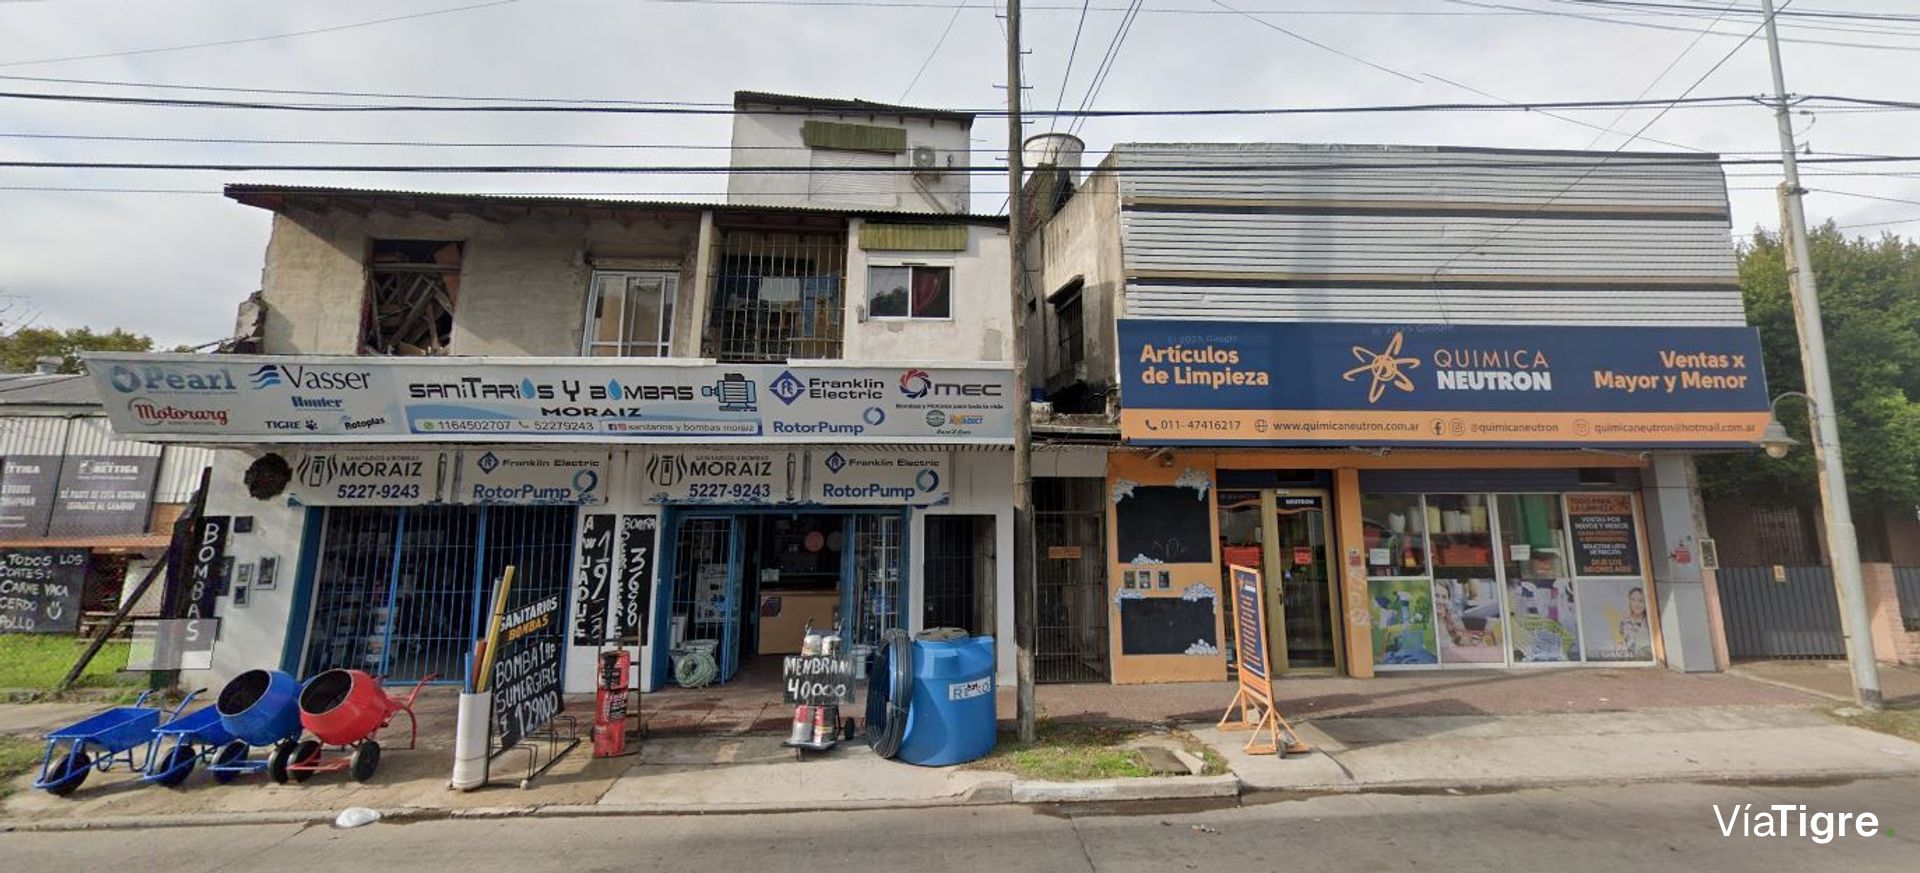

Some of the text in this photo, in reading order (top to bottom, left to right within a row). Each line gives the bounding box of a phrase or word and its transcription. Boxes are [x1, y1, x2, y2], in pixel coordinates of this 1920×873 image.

[1140, 344, 1239, 364] Artículos
[1434, 349, 1549, 369] QUIMICA
[1659, 351, 1746, 368] Ventas x
[145, 368, 237, 390] Pearl
[281, 365, 371, 390] Vasser
[809, 378, 885, 390] Franklin
[1141, 366, 1269, 390] de Limpieza
[1437, 371, 1552, 391] NEUTRON
[1594, 371, 1747, 393] Mayor y Menor
[561, 380, 580, 402] Y
[809, 389, 884, 400] Electric
[134, 403, 229, 426] Motorarg
[541, 407, 642, 417] MORAIZ
[264, 420, 301, 430] TIGRE
[344, 417, 386, 431] Rotoplas
[438, 421, 594, 432] 1164502707 52279243
[773, 420, 864, 436] RotorPump
[1188, 420, 1241, 430] 47416217
[1273, 421, 1419, 433] www.quimicaneutron.com.ar
[1472, 423, 1559, 434] @quimicaneutron
[1594, 423, 1755, 434] quimicaneutron@hotmail.com.ar
[340, 462, 423, 476] MORAIZ
[690, 461, 772, 476] MORAIZ
[849, 459, 940, 467] Franklin Electric
[337, 484, 420, 499] 5227-9243
[473, 484, 571, 503] RotorPump
[689, 483, 771, 498] 5227-9243
[823, 483, 915, 501] RotorPump
[7, 553, 84, 567] TODOS LOS
[1, 579, 69, 597] CARNE VACA
[186, 522, 220, 641] BOMBAS
[0, 596, 37, 612] CERDO
[0, 614, 35, 631] POLLO
[499, 596, 558, 632] SANITARIOS
[508, 614, 549, 641] BOMBAS
[495, 646, 537, 689] BOMBA
[495, 661, 558, 715] SUMERGIBLE
[787, 678, 847, 700] 40000
[514, 690, 559, 738] 129000
